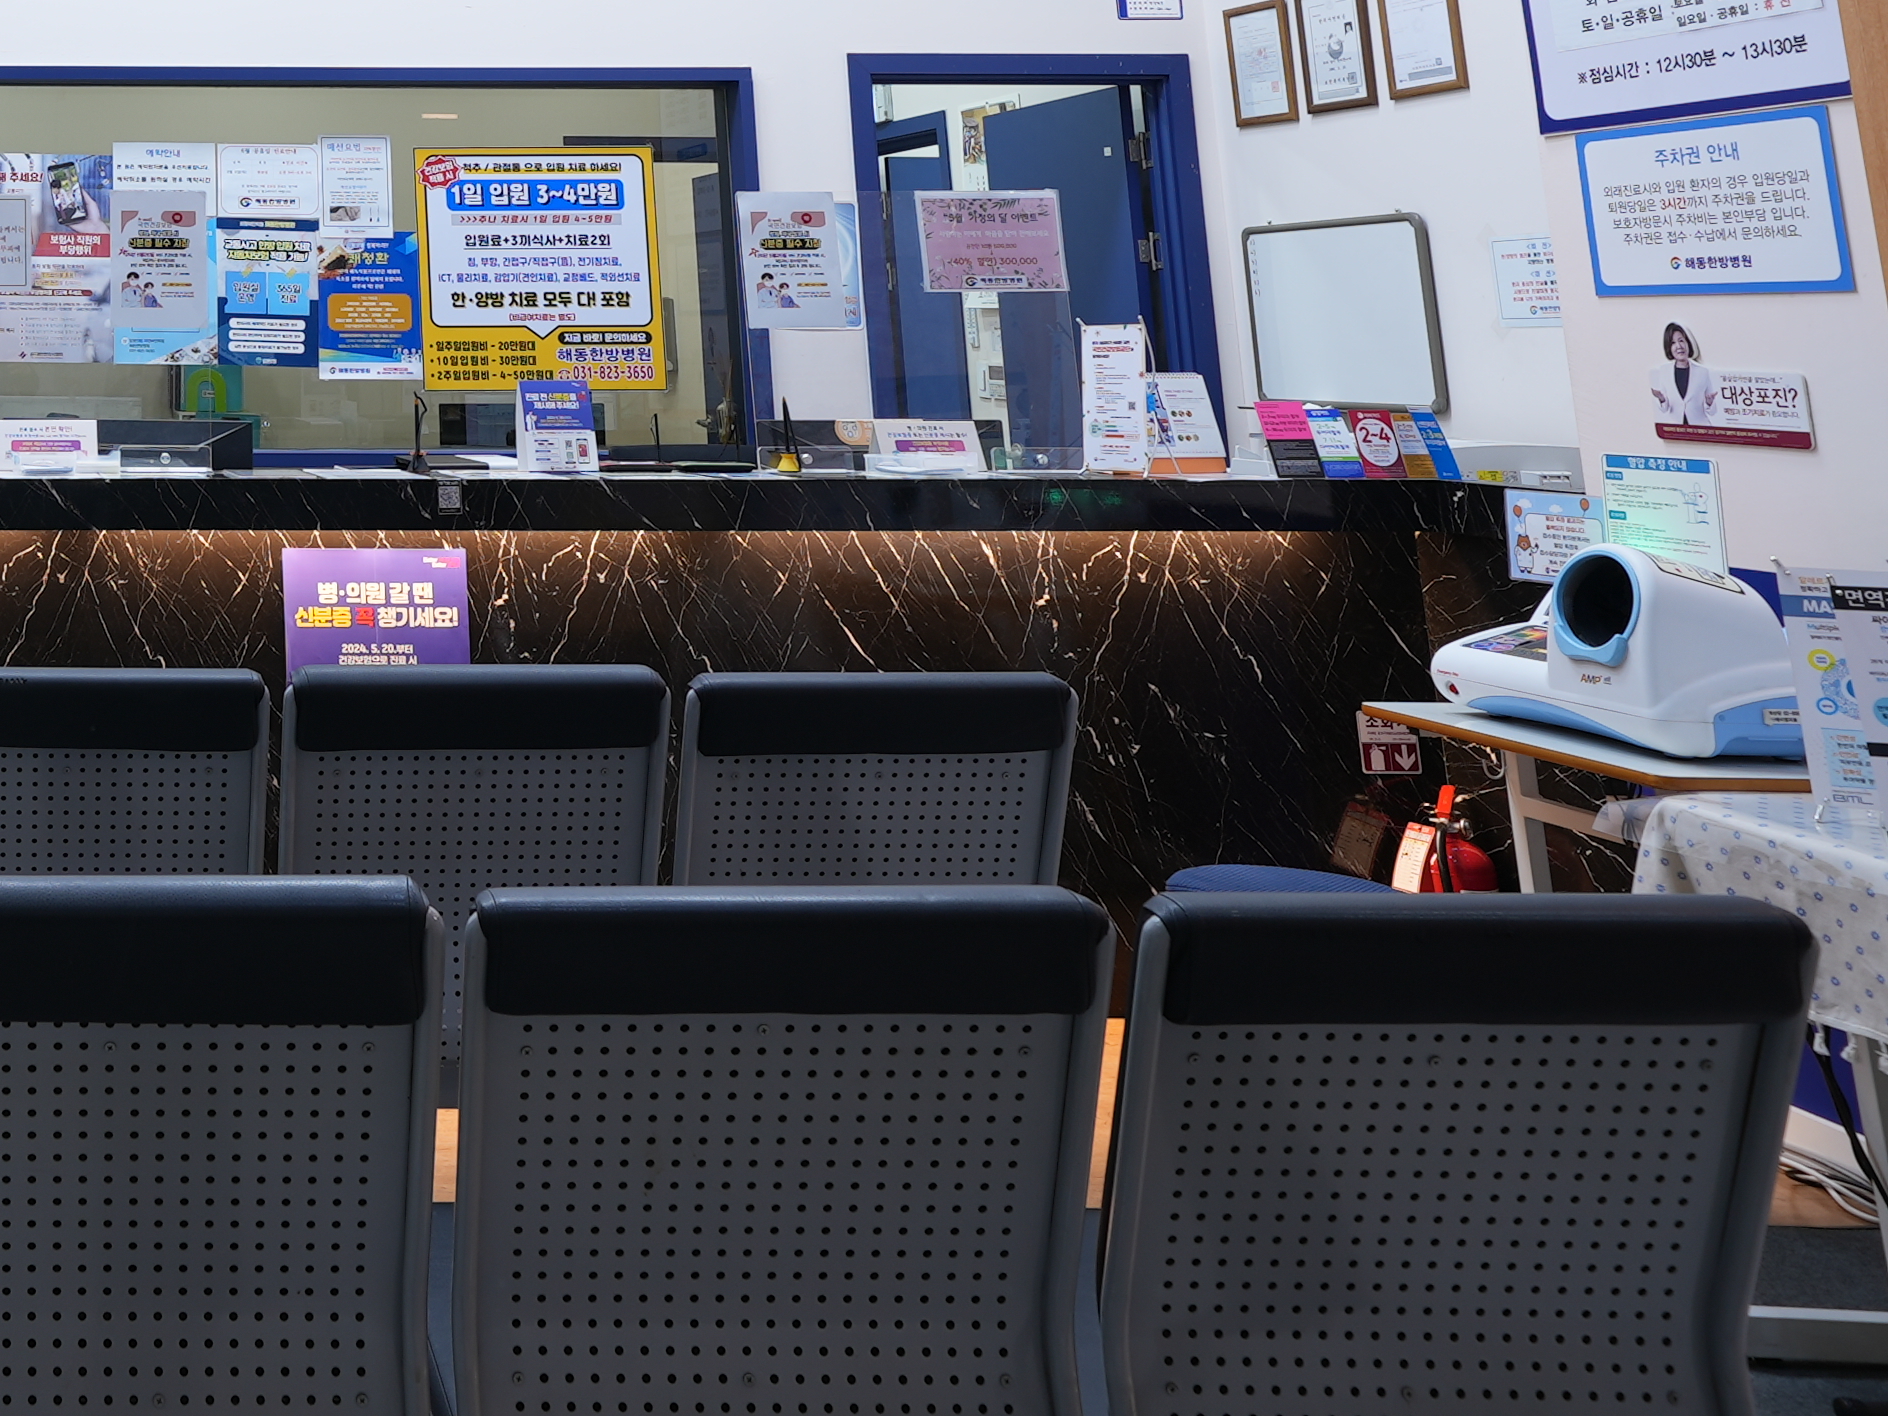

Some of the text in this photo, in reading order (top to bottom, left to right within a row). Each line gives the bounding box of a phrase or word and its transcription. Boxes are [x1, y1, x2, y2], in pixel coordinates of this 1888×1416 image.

[1676, 11, 1707, 27] 일요일
[1717, 4, 1749, 20] 공휴일
[1656, 49, 1717, 74] 12시30분
[1741, 34, 1808, 61] 13시30분
[1654, 142, 1740, 167] 주차권 안내
[524, 162, 621, 172] 으로 입원 치료 하세요!
[10, 172, 43, 183] 주세요!
[1604, 169, 1810, 198] 외래진료시와 입원 환자의 경우 입원당일과
[450, 182, 618, 206] 1일 입원 3~4만원
[1608, 187, 1810, 214] 퇴원당일은 3시간까지 주차권을 드립니다.
[501, 215, 529, 223] 치료시
[534, 215, 547, 223] 1일
[574, 215, 613, 223] 4~5만원
[1613, 205, 1810, 229] 보호자방문시 주차비는 본인부담 입니다.
[464, 234, 611, 248] 입원료+3끼식사+치료2회
[1624, 232, 1663, 246] 주차권은
[1685, 255, 1753, 270] 해동한방병원
[511, 291, 538, 308] 치료
[543, 291, 573, 308] 모두
[577, 291, 596, 308] 다!
[600, 291, 631, 308] 포함
[498, 341, 536, 352] 20만원대
[499, 356, 536, 366] 30만원대
[556, 348, 652, 362] 해동한방병원
[500, 370, 554, 380] 4~50만원대
[573, 365, 654, 380] 031-823-3650
[1721, 386, 1798, 408] 대상포진?
[389, 582, 410, 604] 갈
[413, 582, 434, 604] 땐
[1803, 599, 1835, 614] MA
[295, 607, 459, 627] 신분증 꼭 챙기세요!
[341, 644, 369, 653] 2024.
[408, 655, 417, 665] 시
